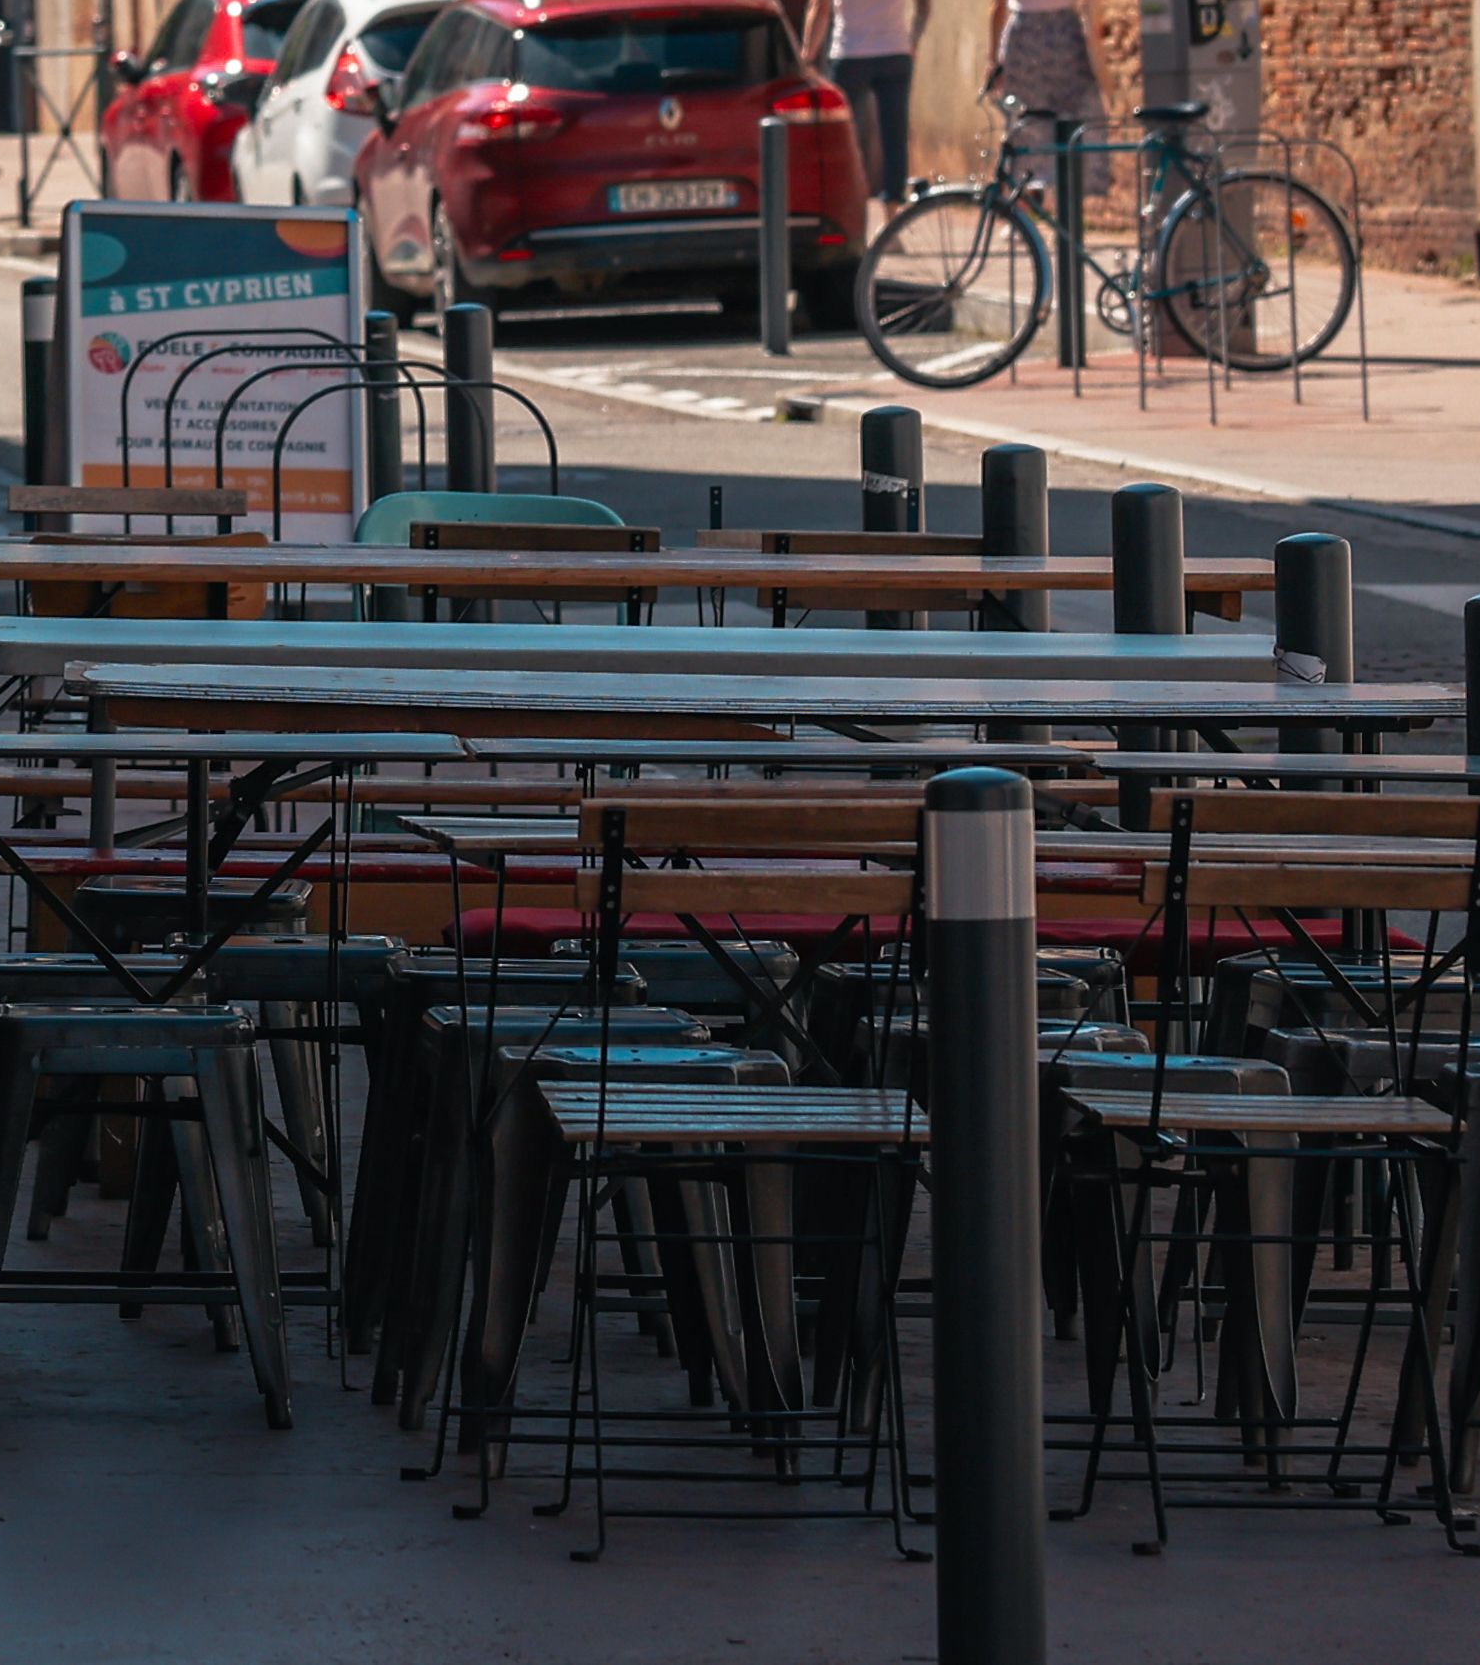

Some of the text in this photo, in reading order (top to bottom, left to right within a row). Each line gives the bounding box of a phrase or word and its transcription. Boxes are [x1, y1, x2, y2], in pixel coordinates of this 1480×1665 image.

[109, 273, 314, 312] à ST CYPRIEN
[158, 438, 220, 450] ANIMAU
[248, 440, 327, 453] COMAGNIE
